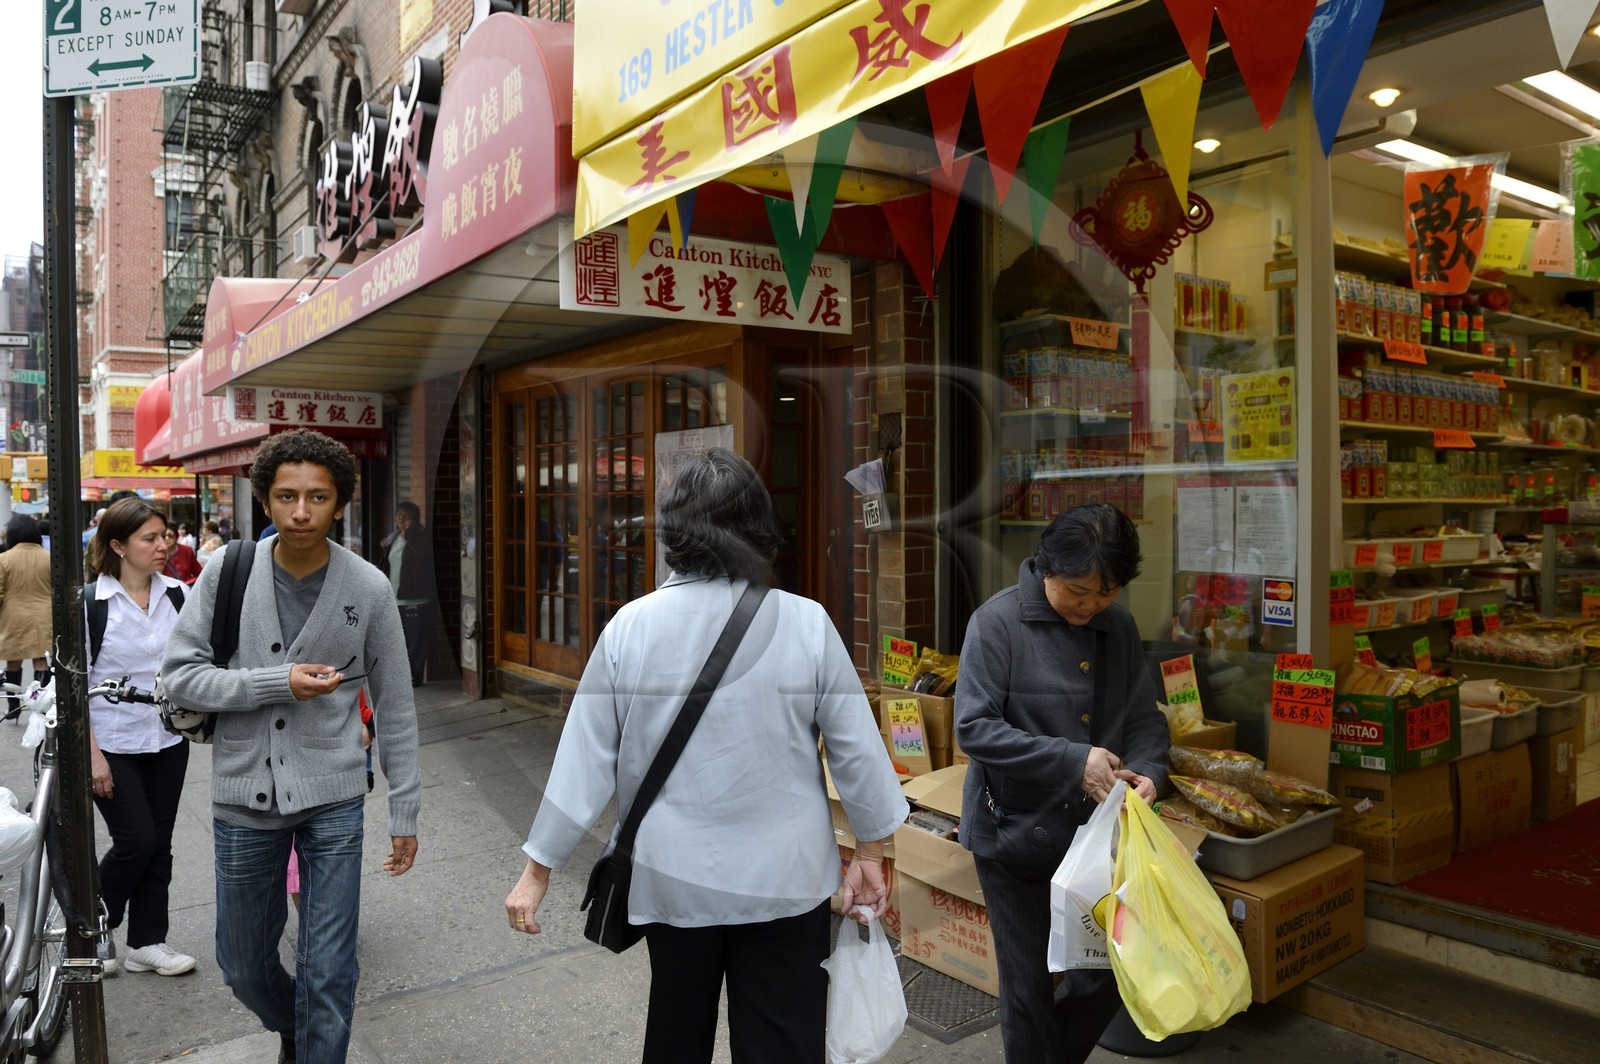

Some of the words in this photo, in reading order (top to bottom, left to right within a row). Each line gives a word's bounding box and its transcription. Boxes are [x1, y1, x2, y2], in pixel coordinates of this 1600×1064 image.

[57, 34, 114, 55] EXCEPT
[124, 26, 184, 48] SUNDAY
[618, 47, 652, 104] 169
[664, 0, 754, 76] HESTER
[441, 146, 523, 242] 晚飯宵夜
[1122, 196, 1153, 233] 福
[1409, 173, 1485, 284] 歡
[650, 238, 724, 265] Canton
[809, 264, 833, 279] NYC
[245, 319, 282, 370] CANTON
[286, 286, 339, 349] KITCHEN
[338, 296, 355, 324] NYC
[371, 239, 421, 302] 343-2623
[641, 264, 842, 327] 進煌飯店
[11, 370, 40, 383] MOTT
[267, 400, 377, 425] 進煌飯店
[271, 389, 311, 400] Canton
[313, 391, 355, 403] Kitchen
[1266, 587, 1292, 596] MasterCard
[1267, 604, 1292, 617] VISA
[1081, 914, 1102, 938] Have
[1275, 937, 1298, 964] NW
[1299, 921, 1332, 953] 20KG
[1084, 948, 1111, 958] Tha
